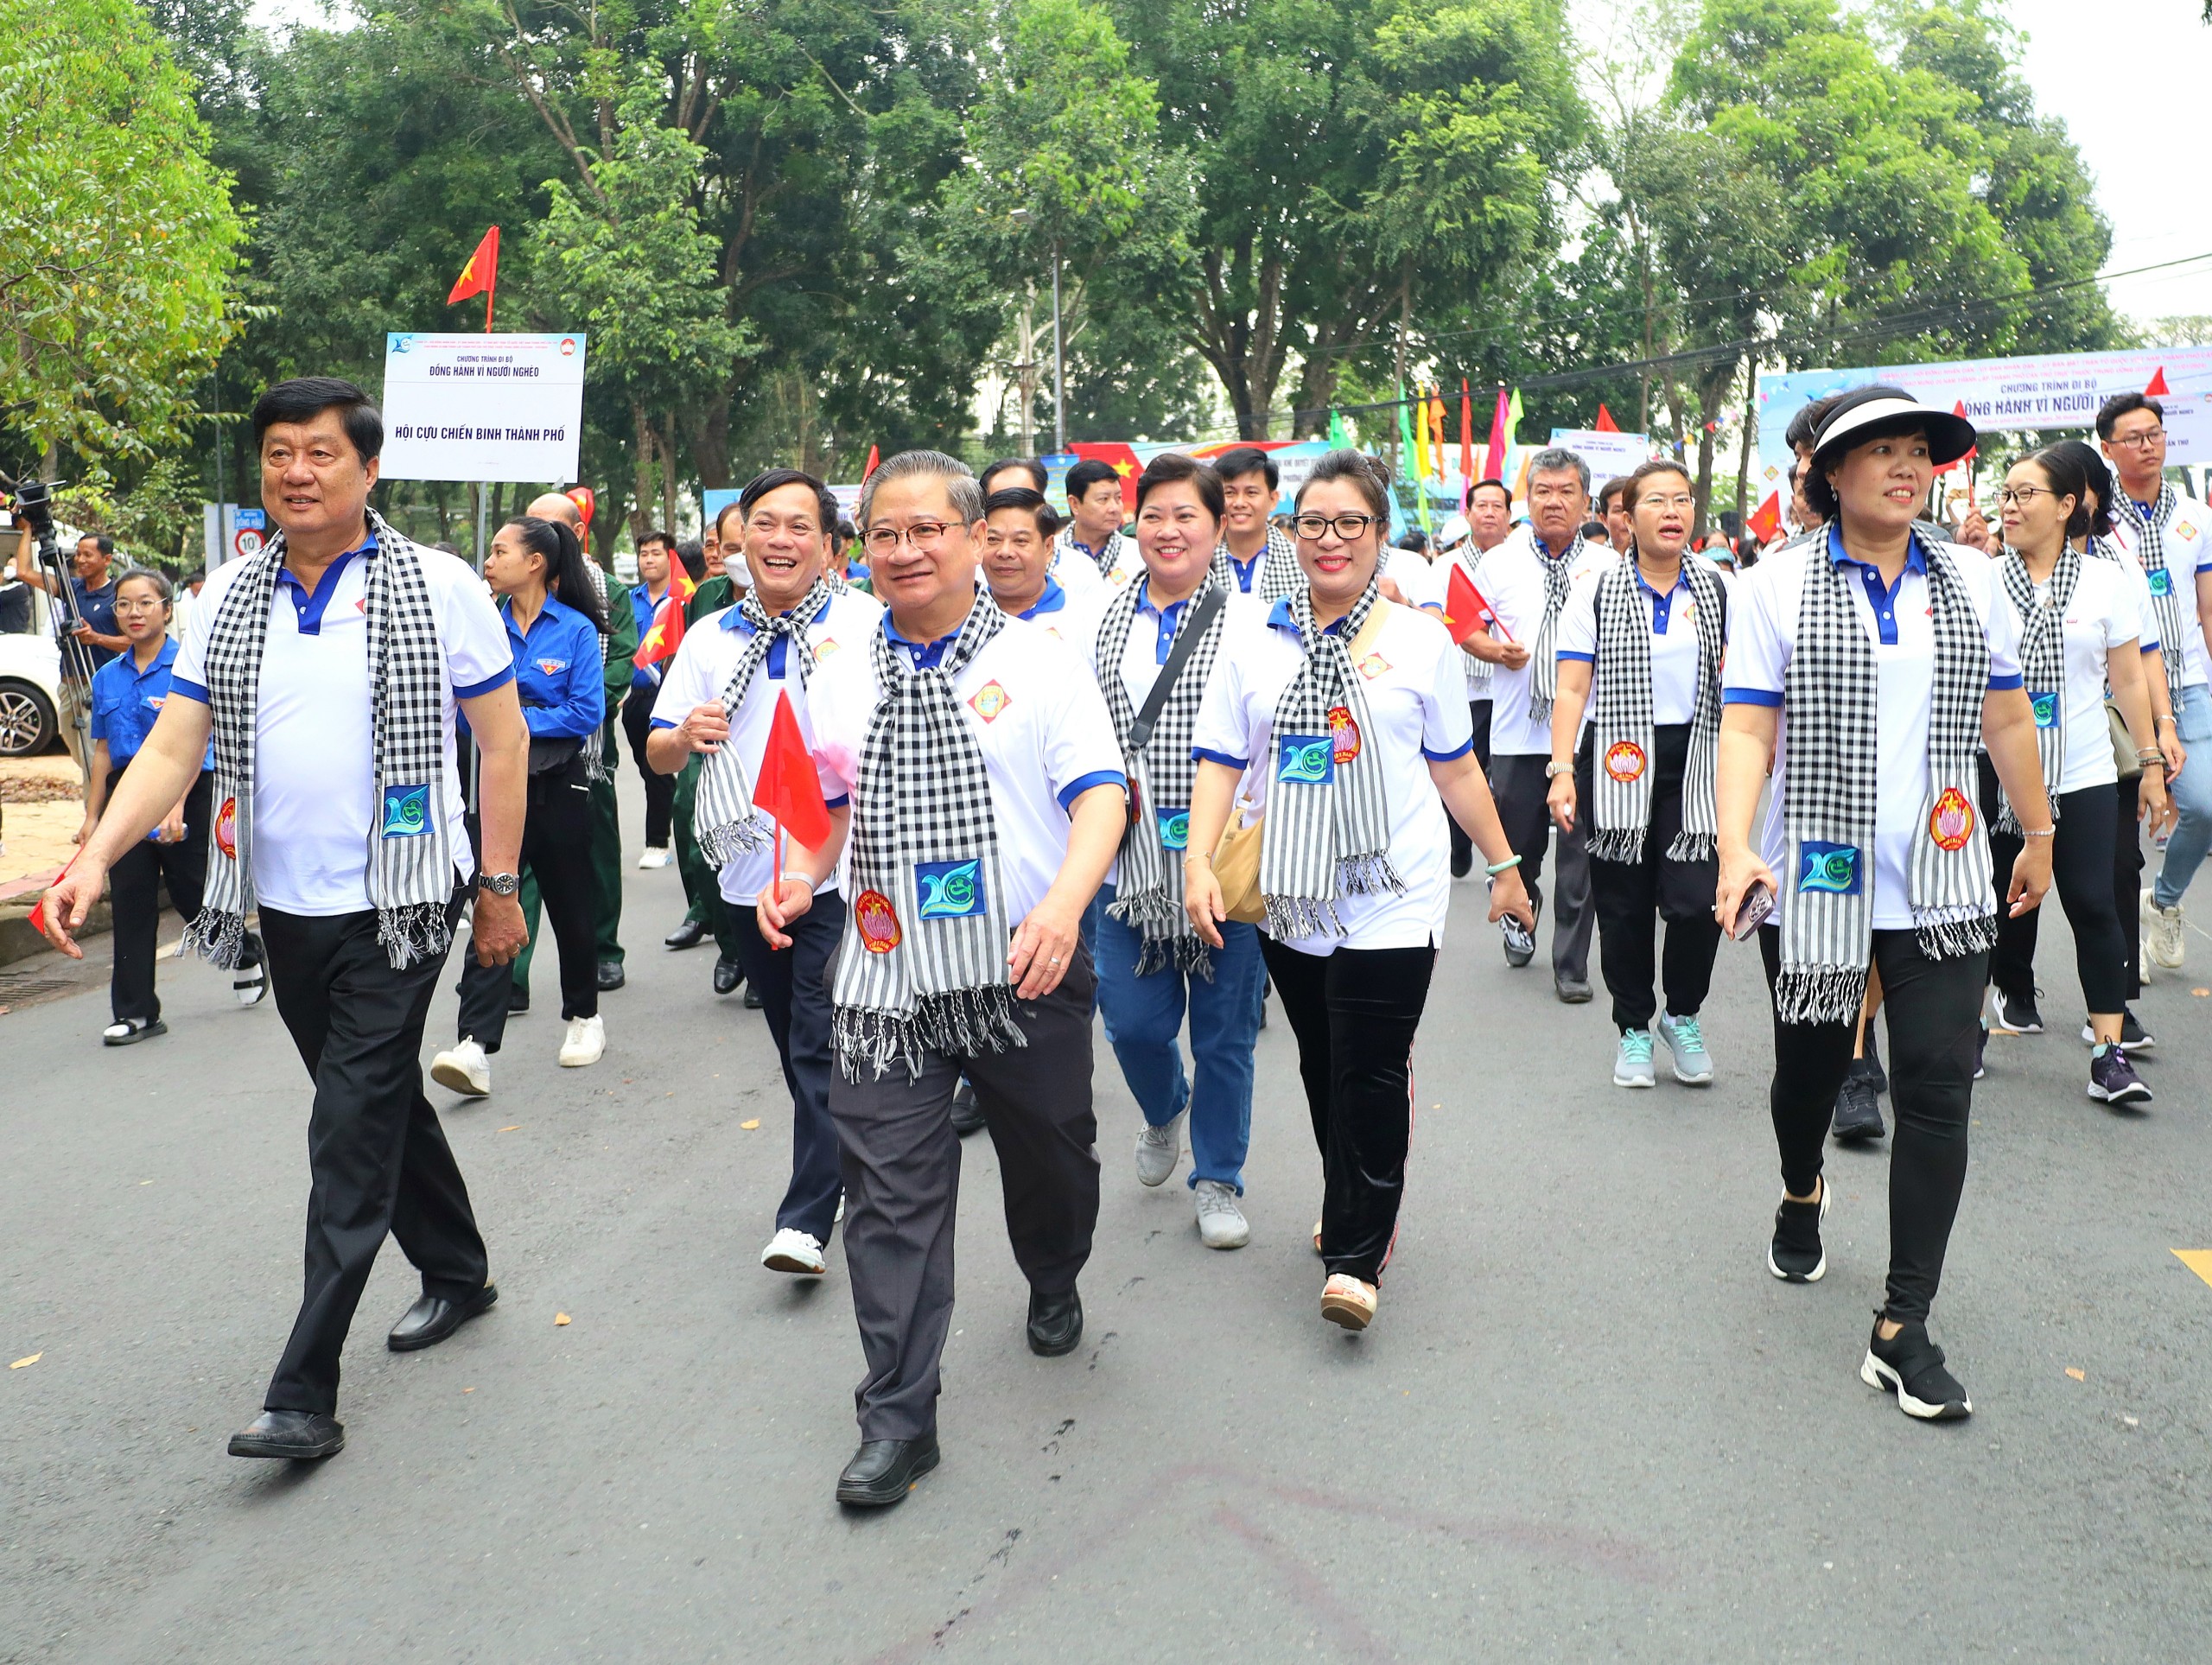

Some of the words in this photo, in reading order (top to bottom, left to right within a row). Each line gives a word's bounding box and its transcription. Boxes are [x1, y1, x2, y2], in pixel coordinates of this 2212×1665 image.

[480, 354, 497, 363] TRÌNH
[505, 354, 513, 364] BỘ
[453, 365, 474, 377] HÀNH
[477, 365, 484, 377] VÌ
[486, 365, 511, 377] NGƯỜI
[512, 365, 539, 377] NGHÈO
[395, 423, 413, 442] HỘI
[416, 425, 438, 442] CỰU
[441, 423, 473, 440] CHIẾN
[476, 428, 502, 440] BINH
[505, 425, 540, 441] THÀNH
[543, 424, 566, 442] PHỐ
